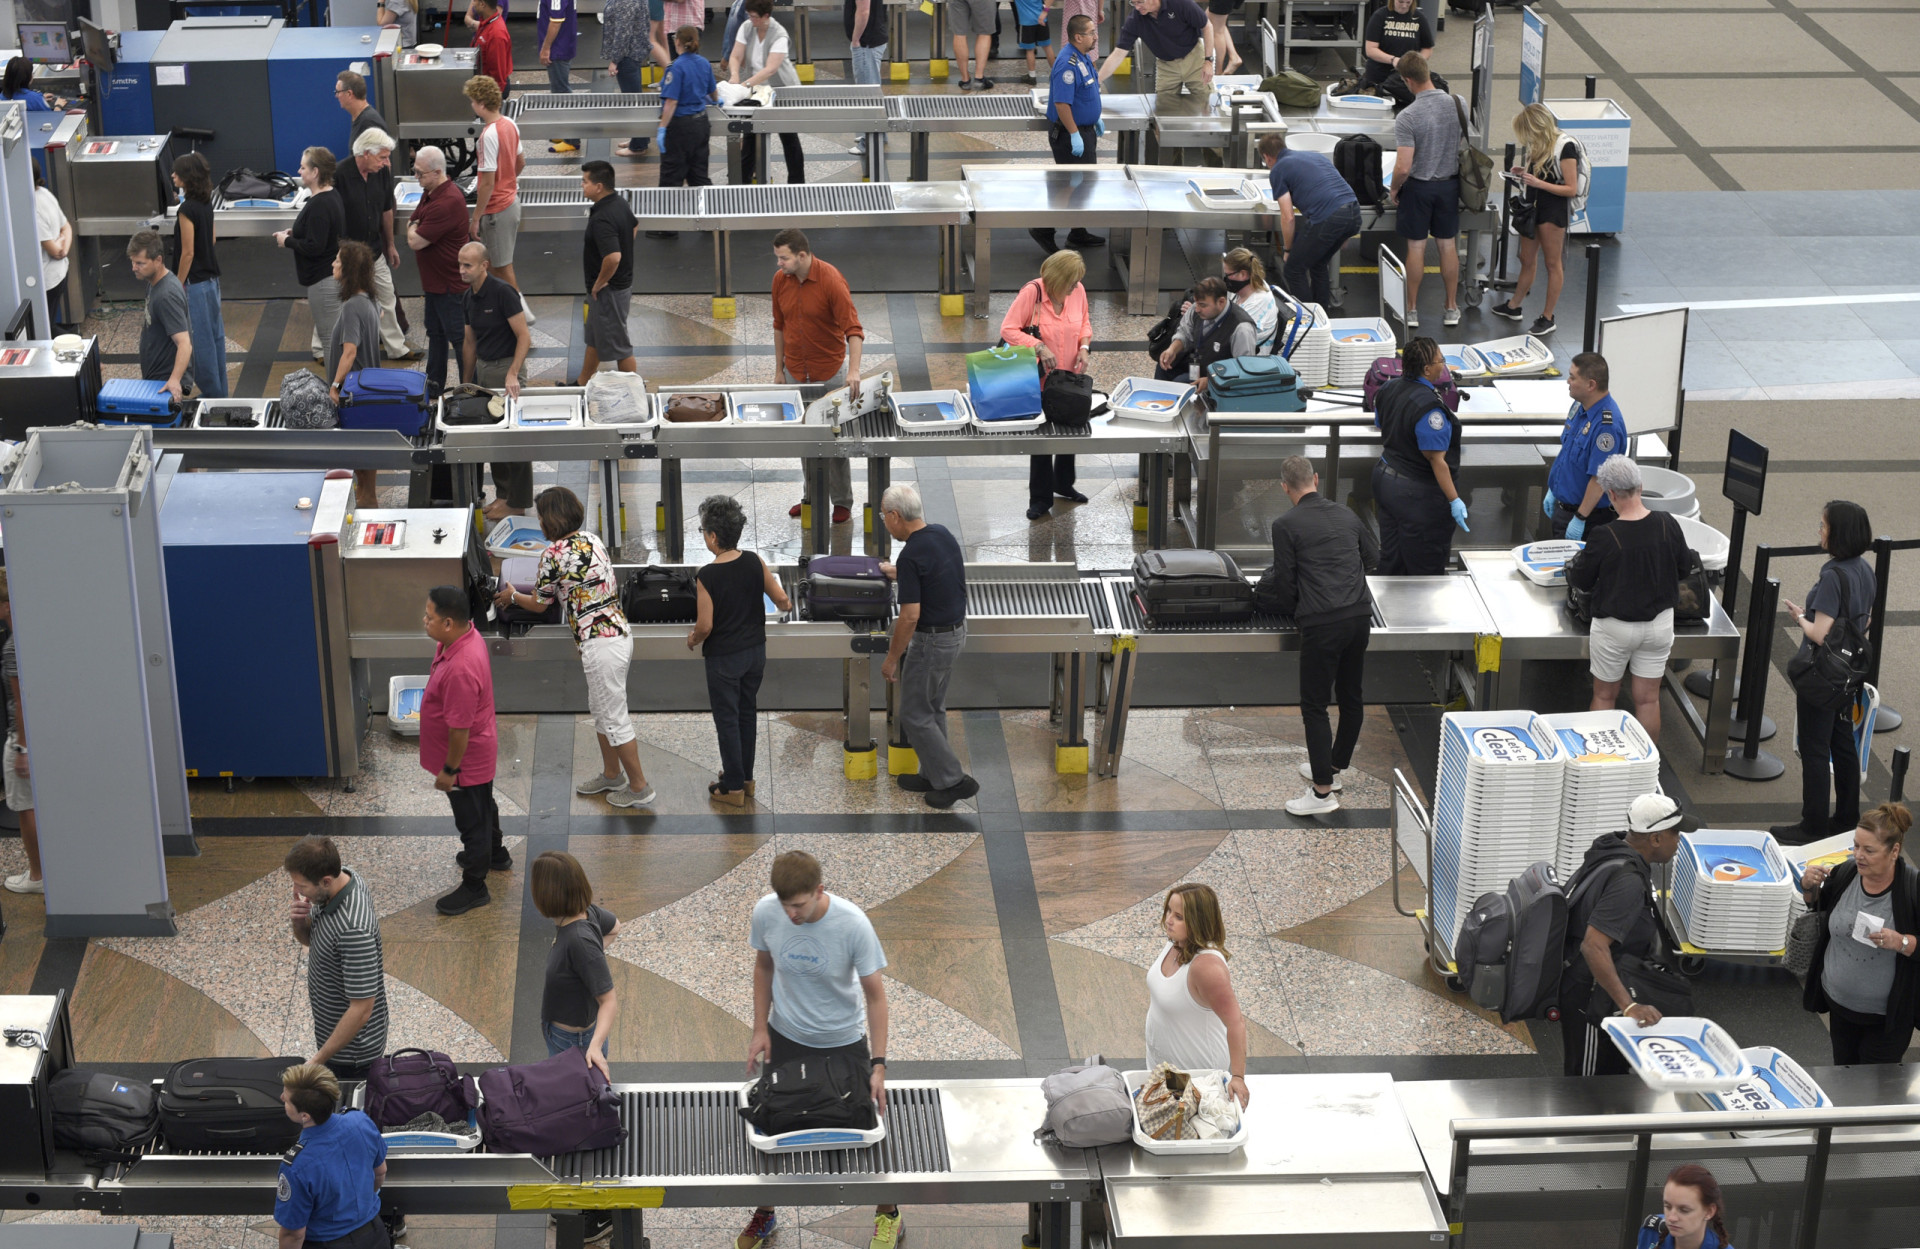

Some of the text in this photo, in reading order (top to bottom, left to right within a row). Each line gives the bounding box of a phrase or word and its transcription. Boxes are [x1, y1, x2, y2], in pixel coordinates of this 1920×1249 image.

[1384, 20, 1420, 32] COLORADO
[1384, 30, 1416, 38] FOOTBALL
[1607, 729, 1622, 744] Need
[1504, 737, 1522, 754] Let's
[1648, 1216, 1658, 1227] TSA
